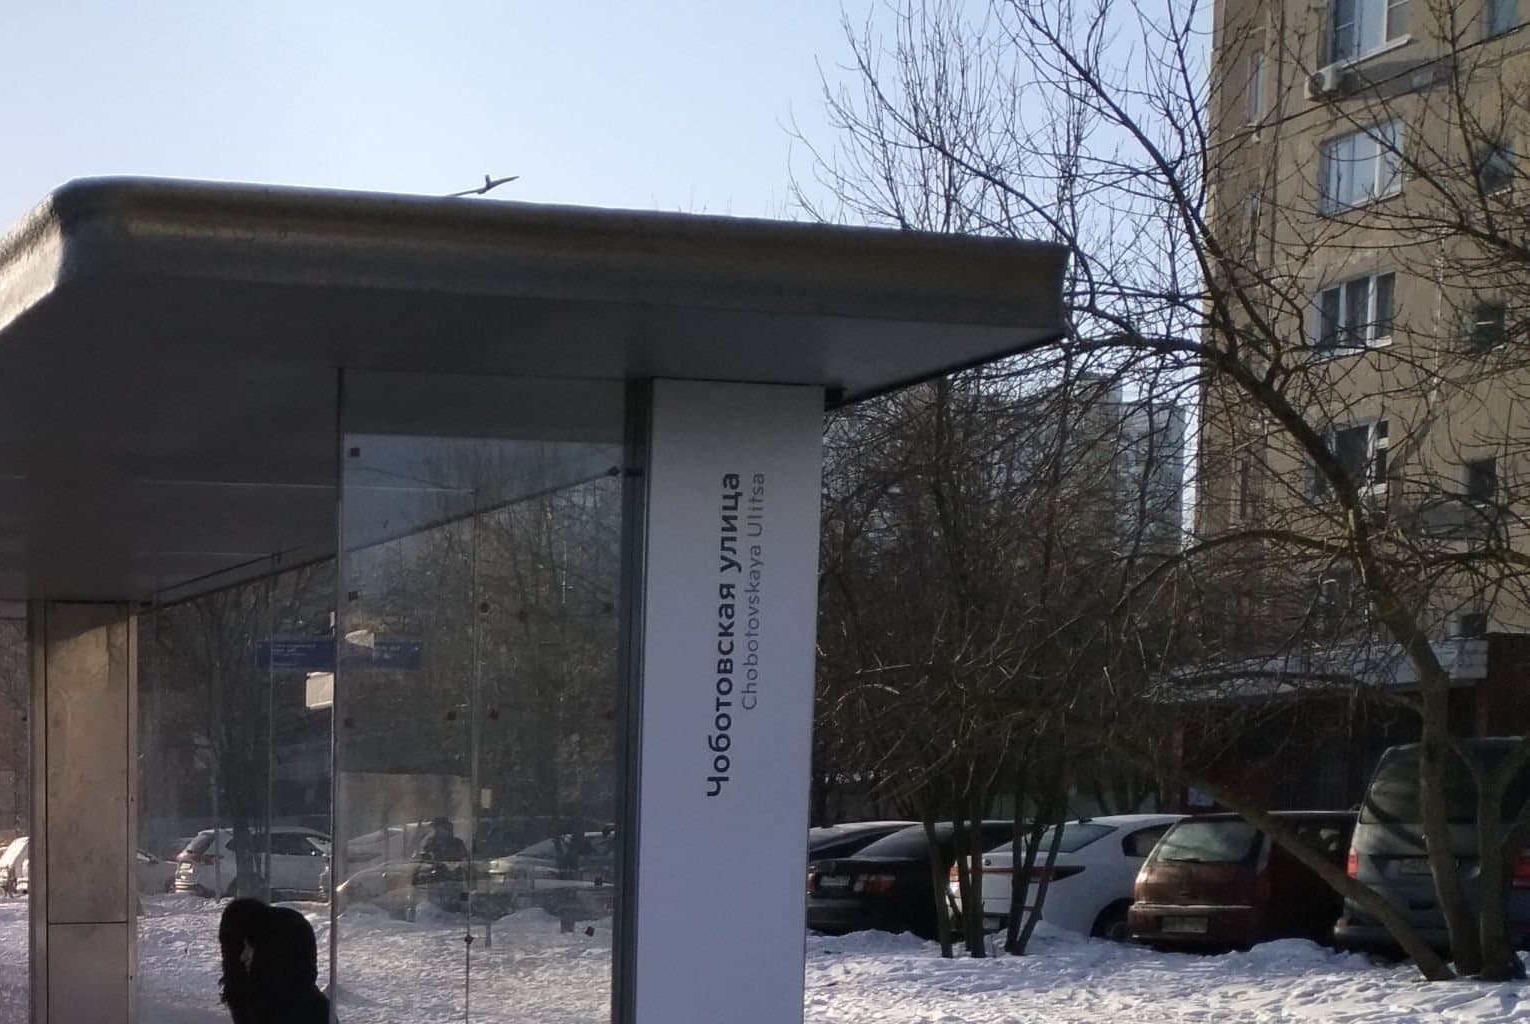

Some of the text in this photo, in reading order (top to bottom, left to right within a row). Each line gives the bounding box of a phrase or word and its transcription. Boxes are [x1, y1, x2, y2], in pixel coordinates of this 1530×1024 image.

[707, 473, 742, 797] Чоботовская улица
[742, 473, 765, 710] Chobotovskaya Ulitsa
